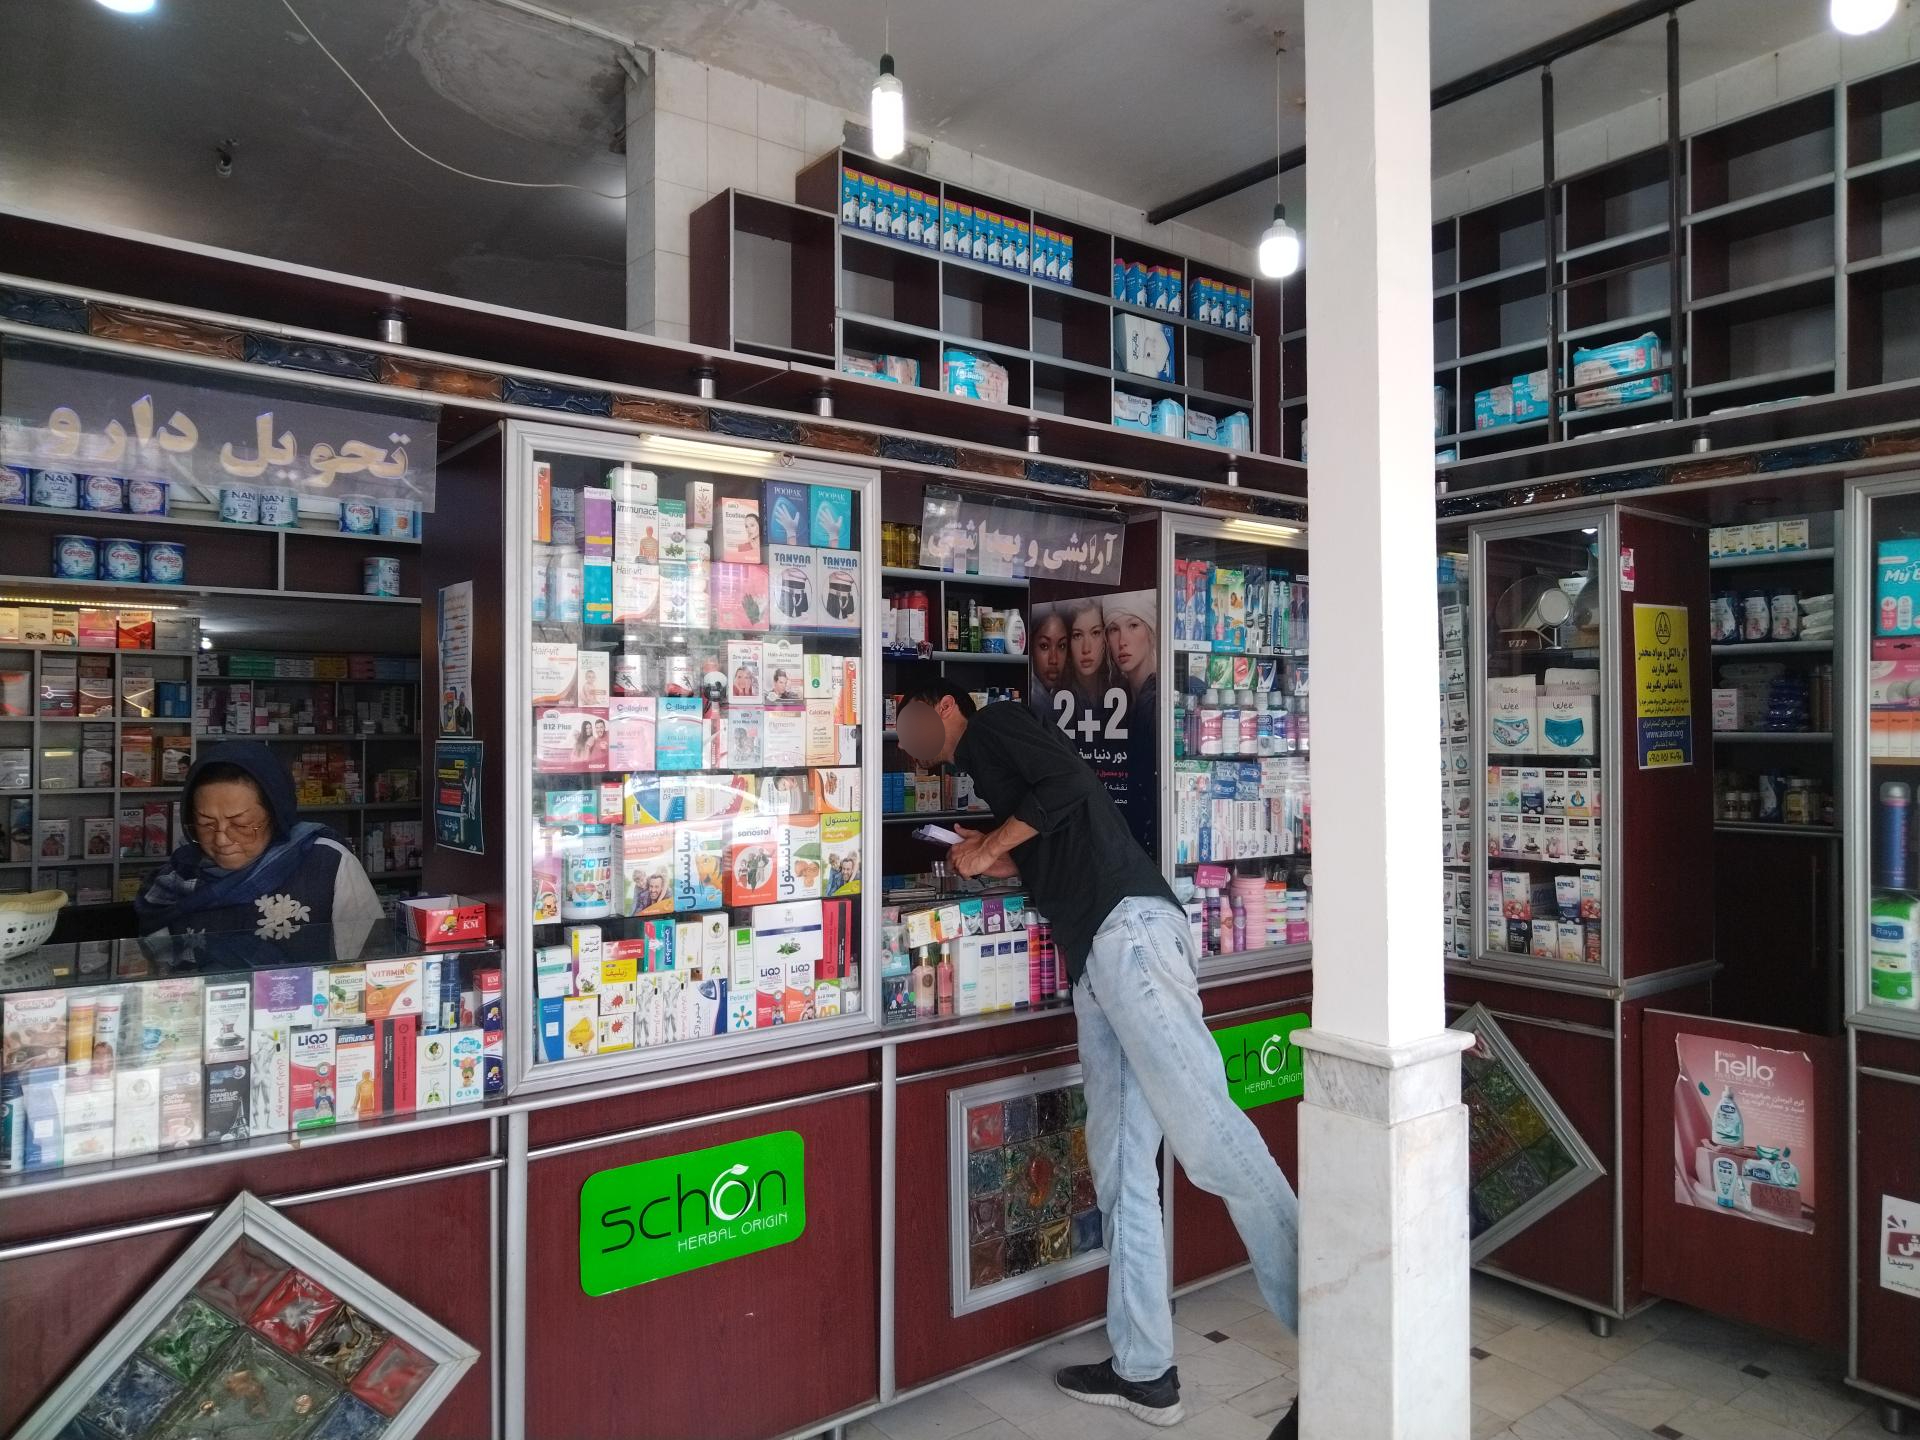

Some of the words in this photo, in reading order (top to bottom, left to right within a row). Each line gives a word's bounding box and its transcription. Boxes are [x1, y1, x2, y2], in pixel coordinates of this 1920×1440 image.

[47, 394, 199, 462] دارو
[219, 411, 412, 488] تحویل
[44, 473, 73, 485] NAN
[231, 490, 256, 501] NAN
[261, 494, 284, 503] NAN
[242, 510, 248, 520] 2
[269, 513, 275, 522] 2
[1024, 539, 1039, 567] و
[1043, 532, 1118, 574] آرایشی
[1884, 567, 1910, 585] My
[890, 641, 905, 652] 2+2
[1053, 687, 1129, 743] 2+2
[543, 723, 556, 731] B12
[1093, 748, 1111, 763] دنیا
[1111, 750, 1128, 764] دور
[677, 830, 697, 909] سانستول
[779, 827, 796, 896] سانستول
[1875, 926, 1899, 938] Raya
[1714, 1049, 1774, 1082] hello
[1244, 1077, 1276, 1095] HERBAL
[1277, 1071, 1304, 1087] ORIGIN
[677, 1226, 736, 1254] HERBAL
[741, 1211, 789, 1236] ORIGIN
